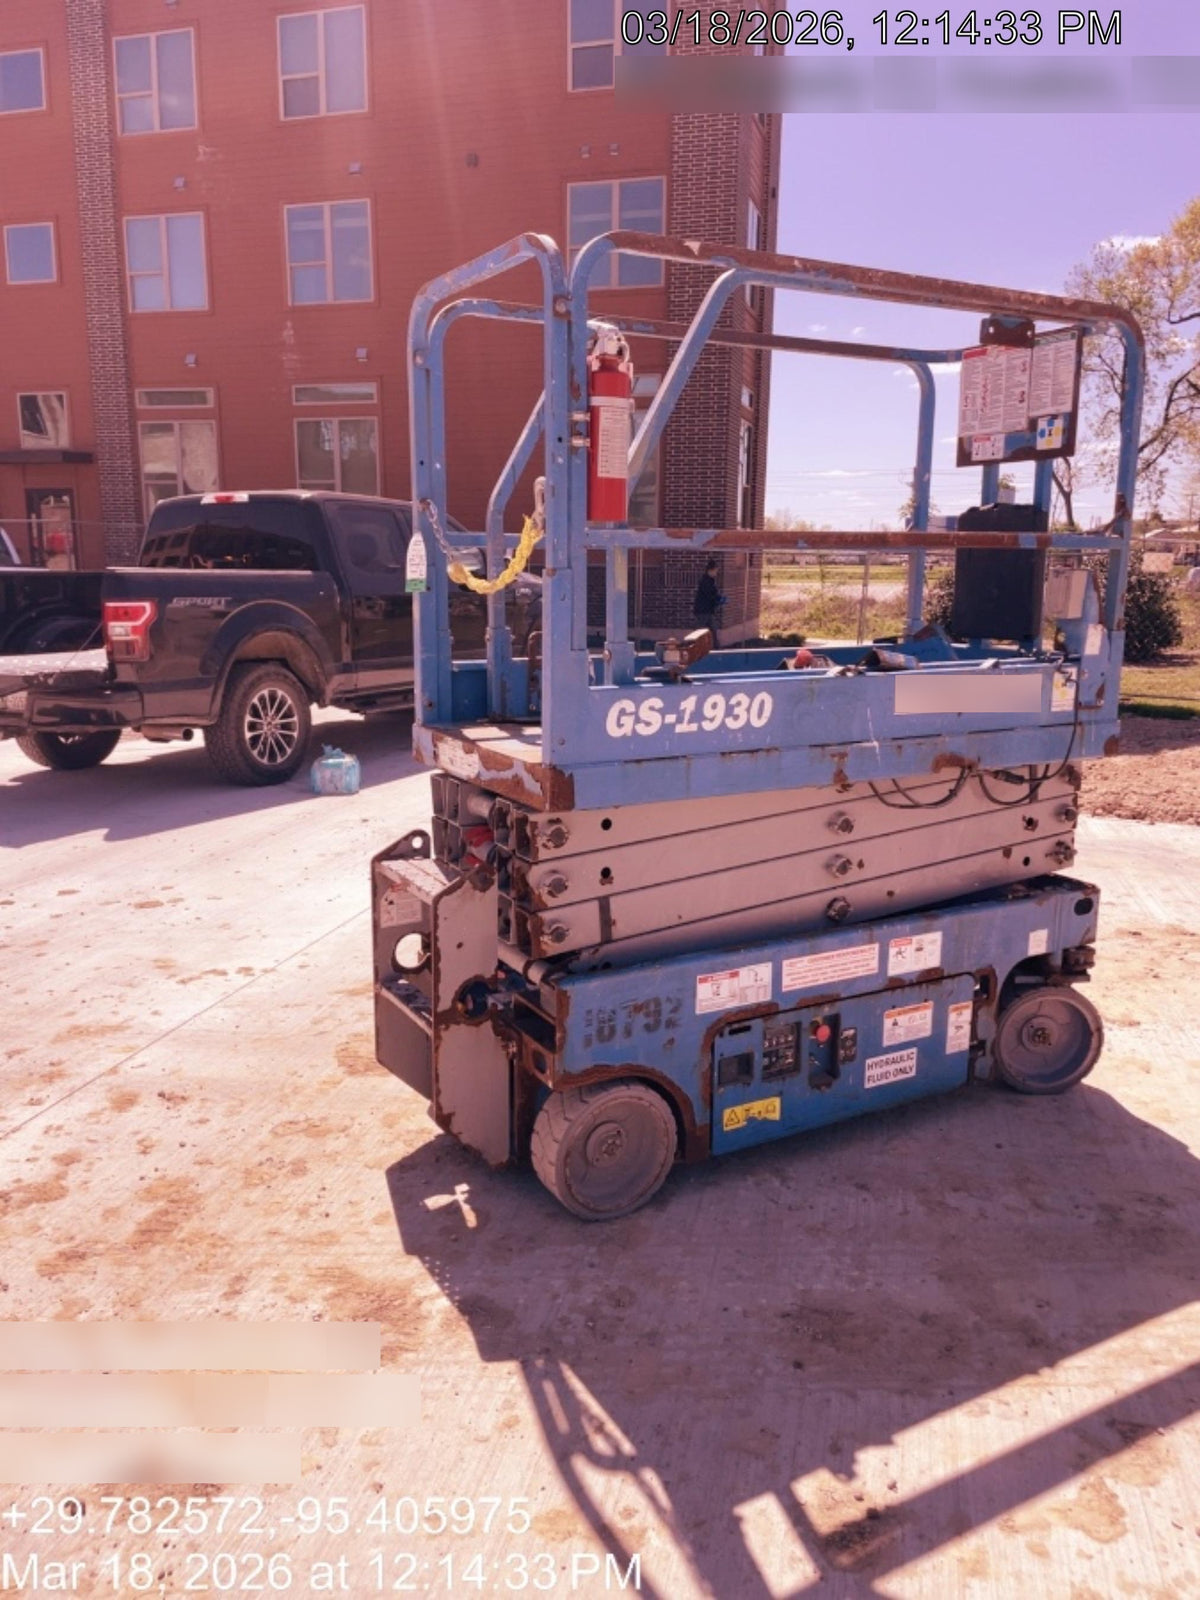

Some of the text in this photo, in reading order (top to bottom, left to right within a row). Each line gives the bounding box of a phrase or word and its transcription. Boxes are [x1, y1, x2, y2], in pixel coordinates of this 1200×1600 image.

[606, 692, 773, 737] GS-1930
[867, 1051, 915, 1071] HYDRAULIC
[867, 1064, 915, 1085] FLUID ONLY
